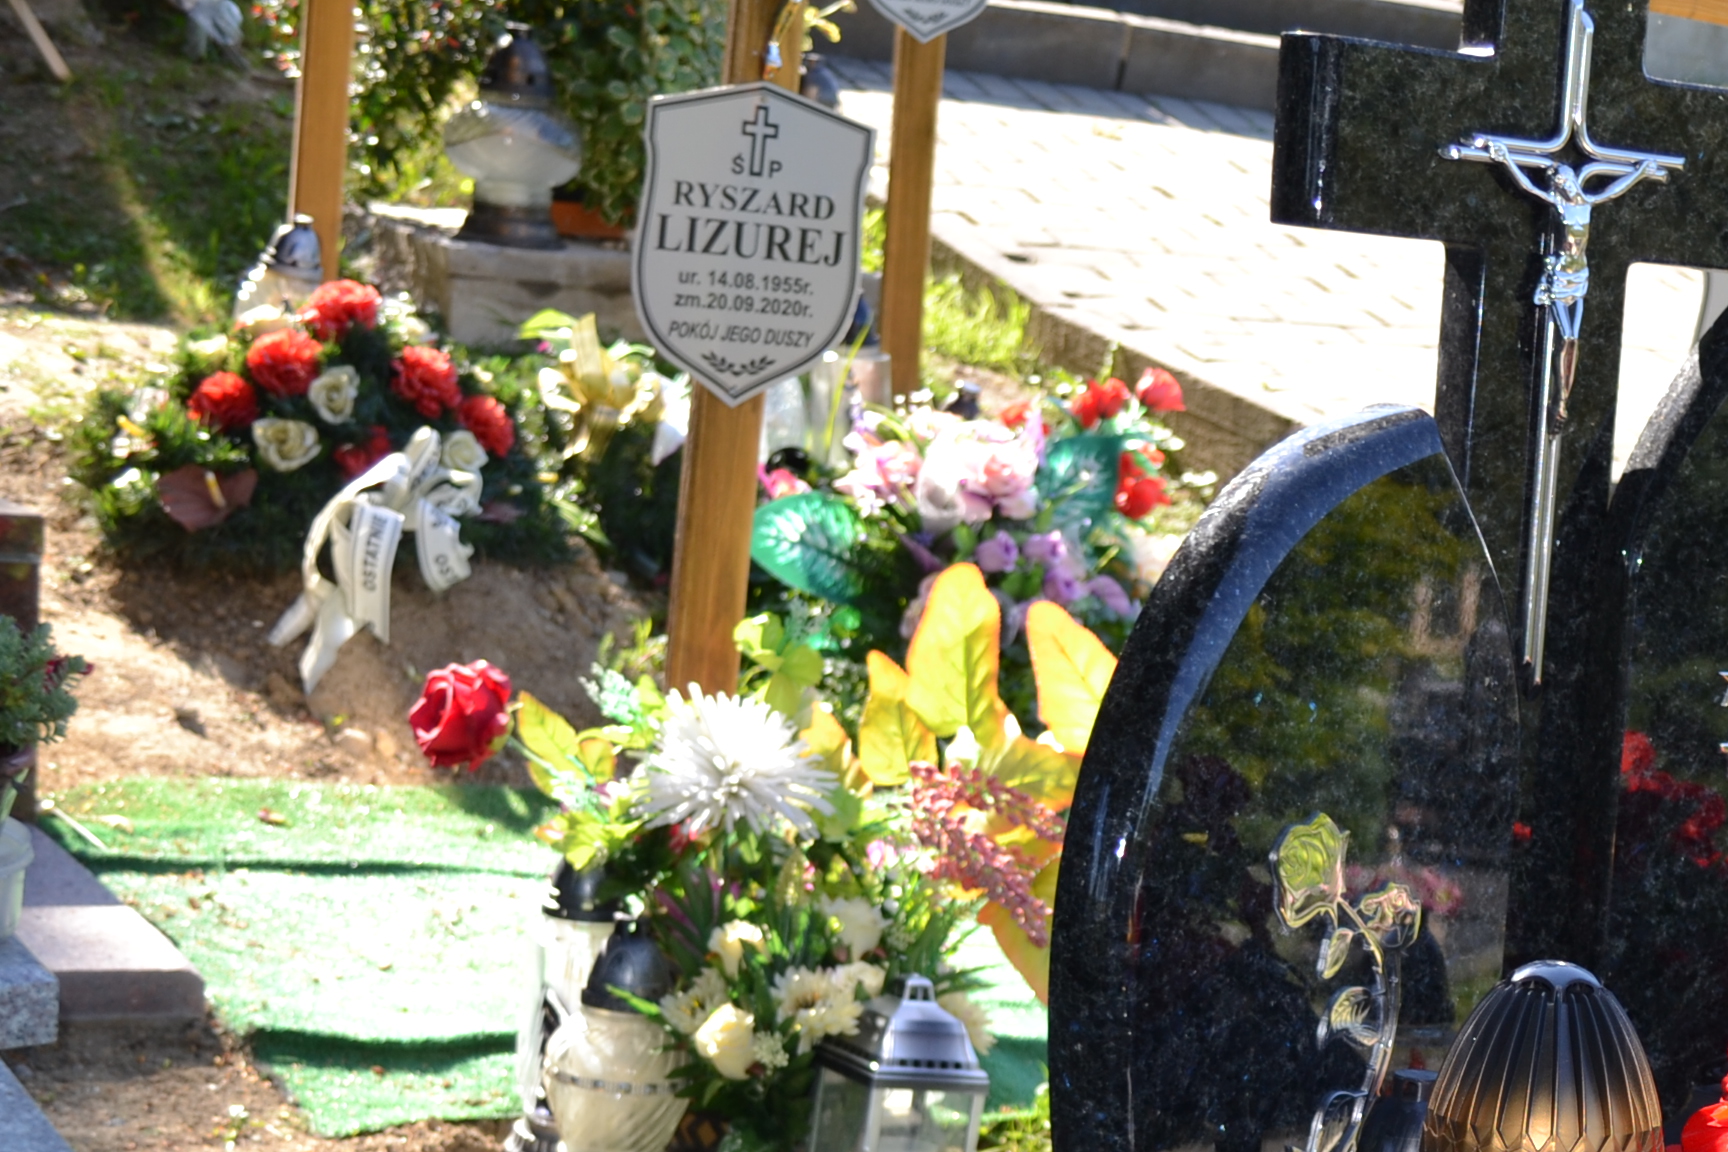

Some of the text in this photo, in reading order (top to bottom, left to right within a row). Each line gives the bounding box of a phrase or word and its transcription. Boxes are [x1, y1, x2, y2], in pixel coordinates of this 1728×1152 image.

[768, 161, 783, 178] P
[672, 180, 835, 221] RYSZARD
[655, 213, 848, 268] LIZUREJ
[678, 270, 814, 296] ur. 14.08.1955r.
[668, 320, 815, 348] POKÓJ JEGO DUSZY
[362, 514, 388, 592] OSTATNIE
